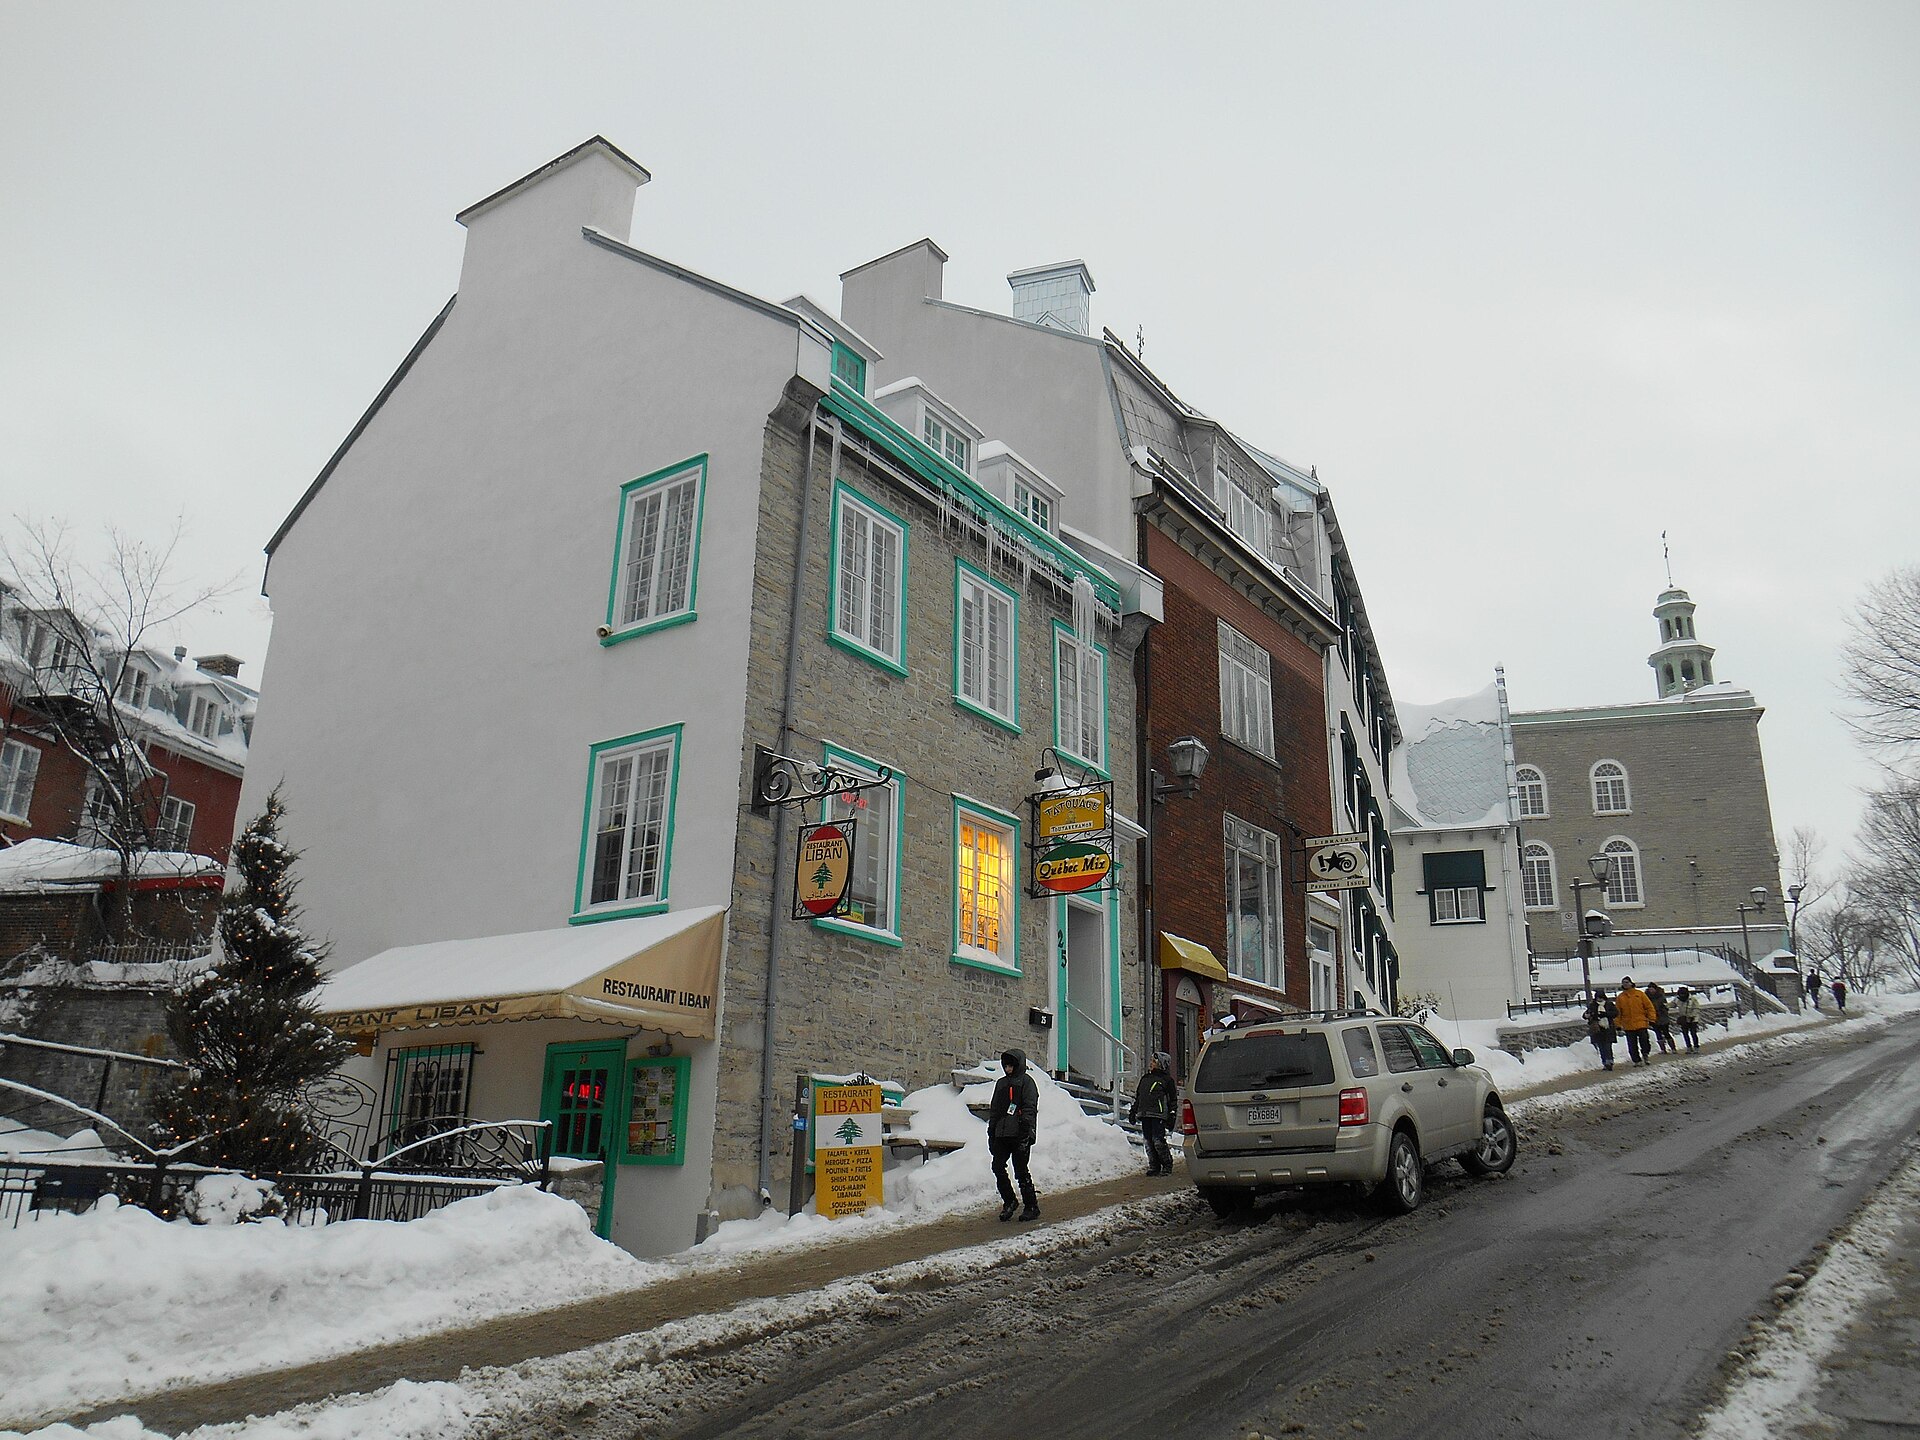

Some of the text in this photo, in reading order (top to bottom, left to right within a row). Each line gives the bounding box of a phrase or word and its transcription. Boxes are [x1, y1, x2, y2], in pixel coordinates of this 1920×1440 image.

[1044, 798, 1100, 816] TATOUAGE
[806, 840, 843, 850] RESTAURANT
[1314, 836, 1359, 845] LIBRAIRIE
[805, 847, 842, 862] LIBAN
[1039, 856, 1105, 879] Québec Mix
[1346, 879, 1366, 887] ISSUE
[602, 977, 711, 1010] RESTAURANT LIBAN
[415, 1001, 500, 1022] LIBAN
[823, 1089, 873, 1099] RESTAURANT
[823, 1098, 873, 1113] LIBAN
[825, 1158, 850, 1166] MERGUEZ
[831, 1174, 867, 1183] SHISH TAOUK
[831, 1183, 866, 1192] SOUS-MARIN
[837, 1190, 862, 1199] LIBANAIS
[831, 1200, 867, 1209] SOUS-MARIN
